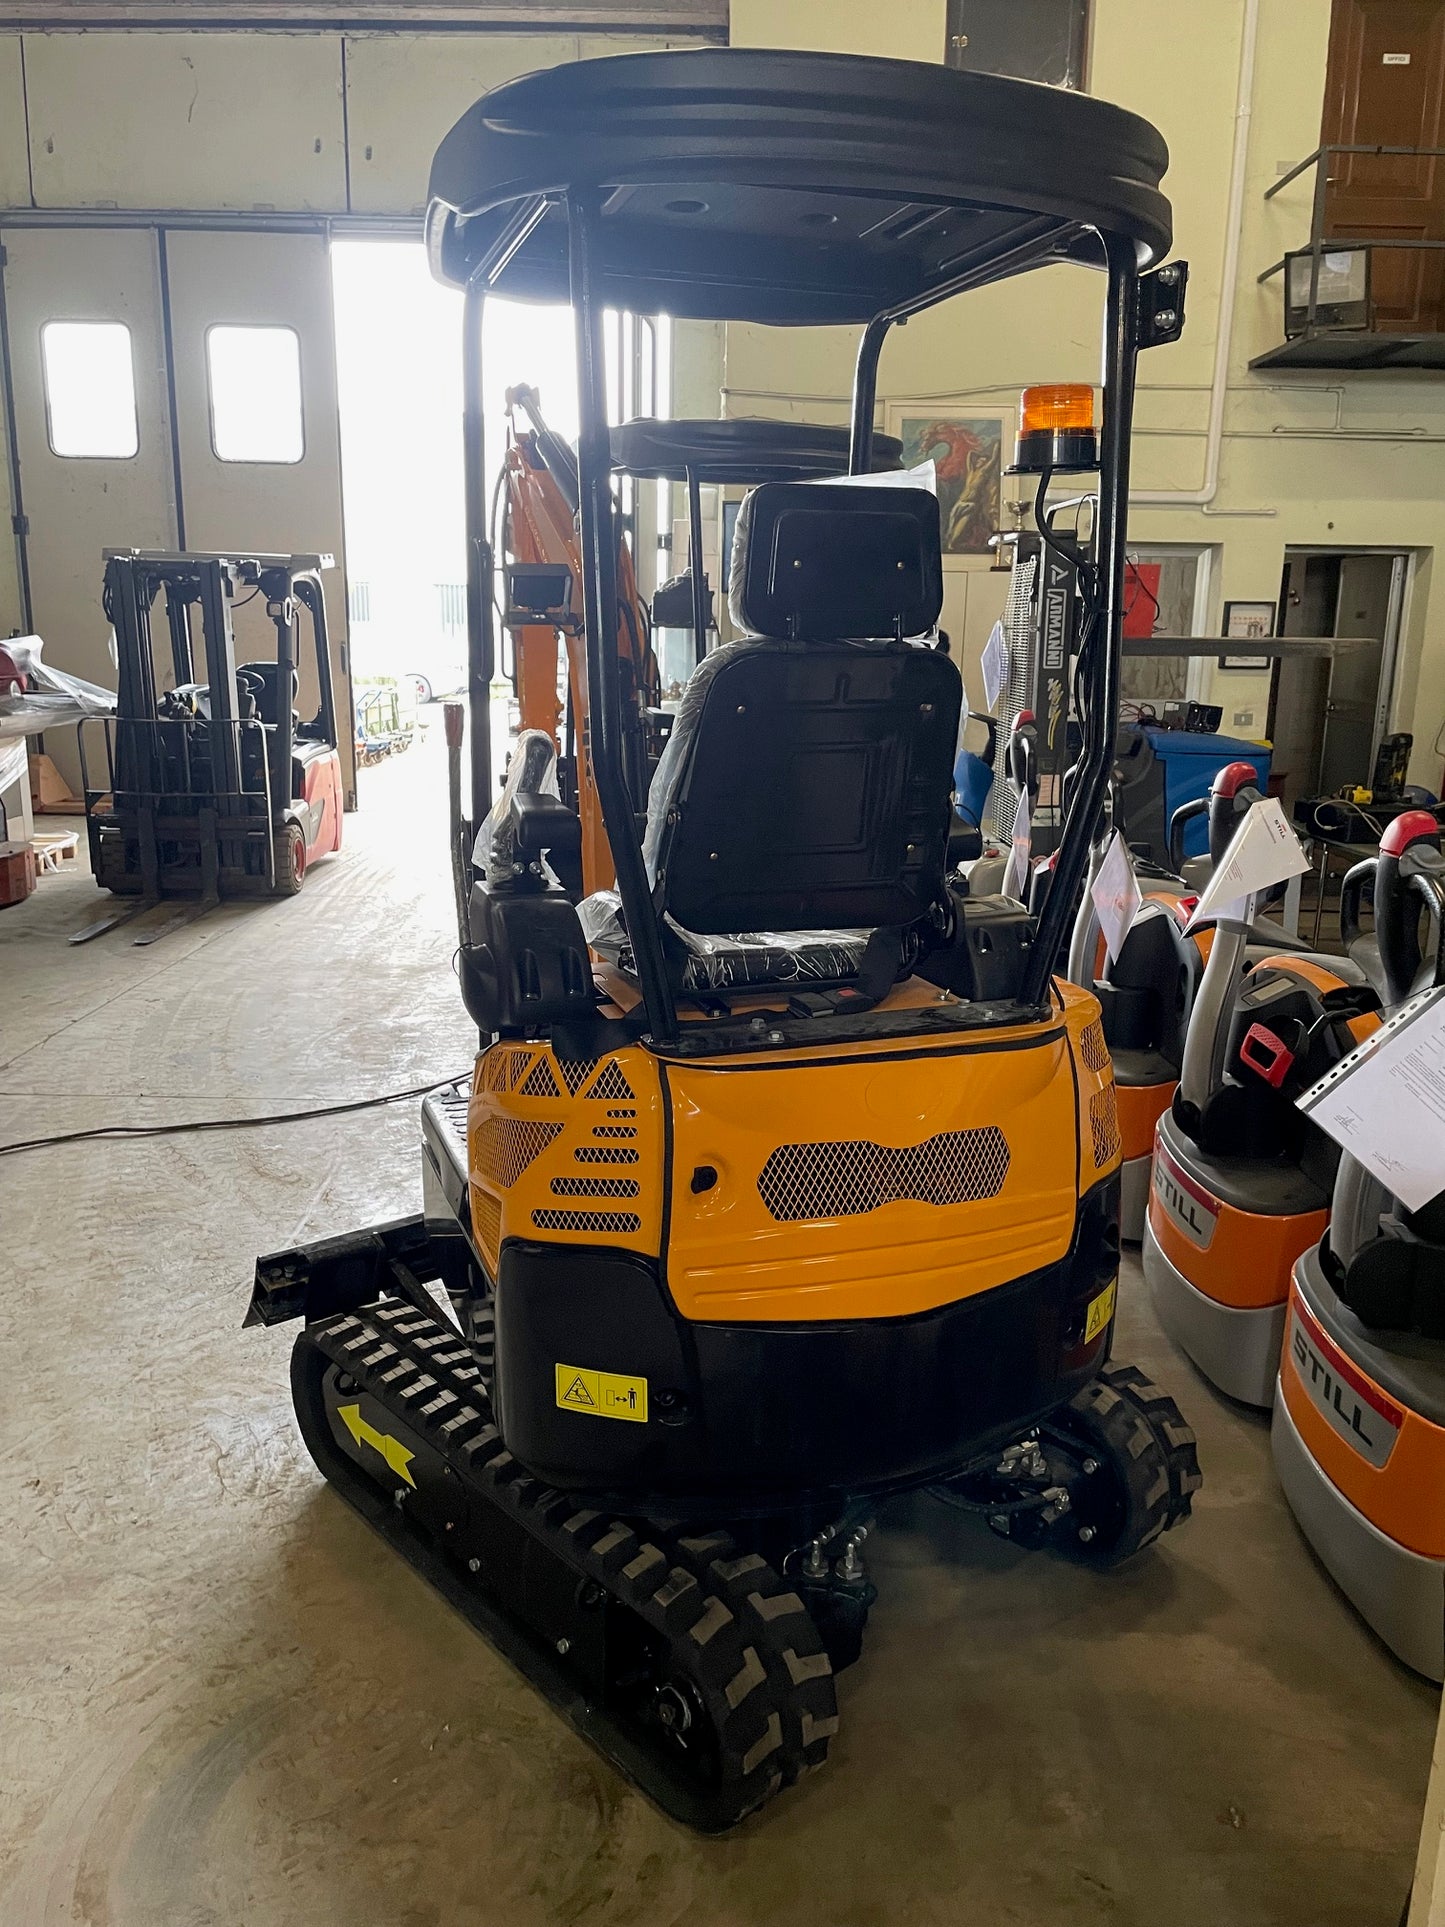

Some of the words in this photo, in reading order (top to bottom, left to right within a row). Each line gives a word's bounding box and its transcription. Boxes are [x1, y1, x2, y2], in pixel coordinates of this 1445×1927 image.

[1046, 592, 1064, 666] ARMANNI
[1156, 1161, 1202, 1235] STILL
[1293, 1328, 1373, 1447] STILL
